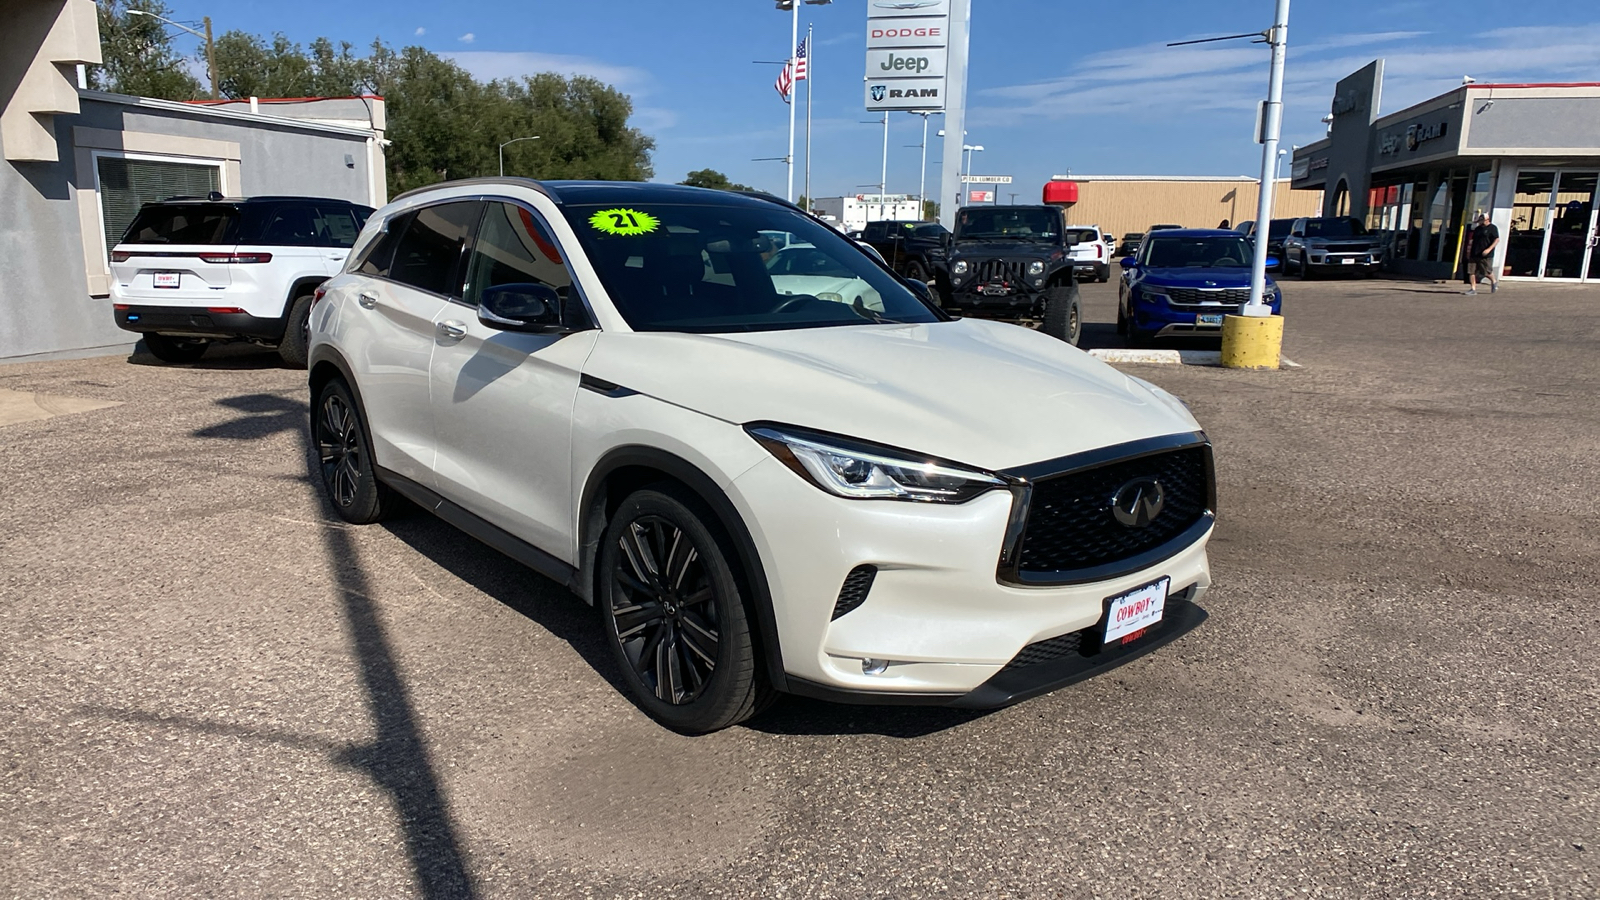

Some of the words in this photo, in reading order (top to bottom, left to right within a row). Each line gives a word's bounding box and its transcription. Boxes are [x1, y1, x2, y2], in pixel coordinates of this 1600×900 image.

[871, 28, 941, 38] DODGE
[880, 53, 929, 73] Jeep
[889, 88, 938, 98] RAM
[608, 213, 639, 228] 21
[1116, 597, 1151, 622] COWBOY
